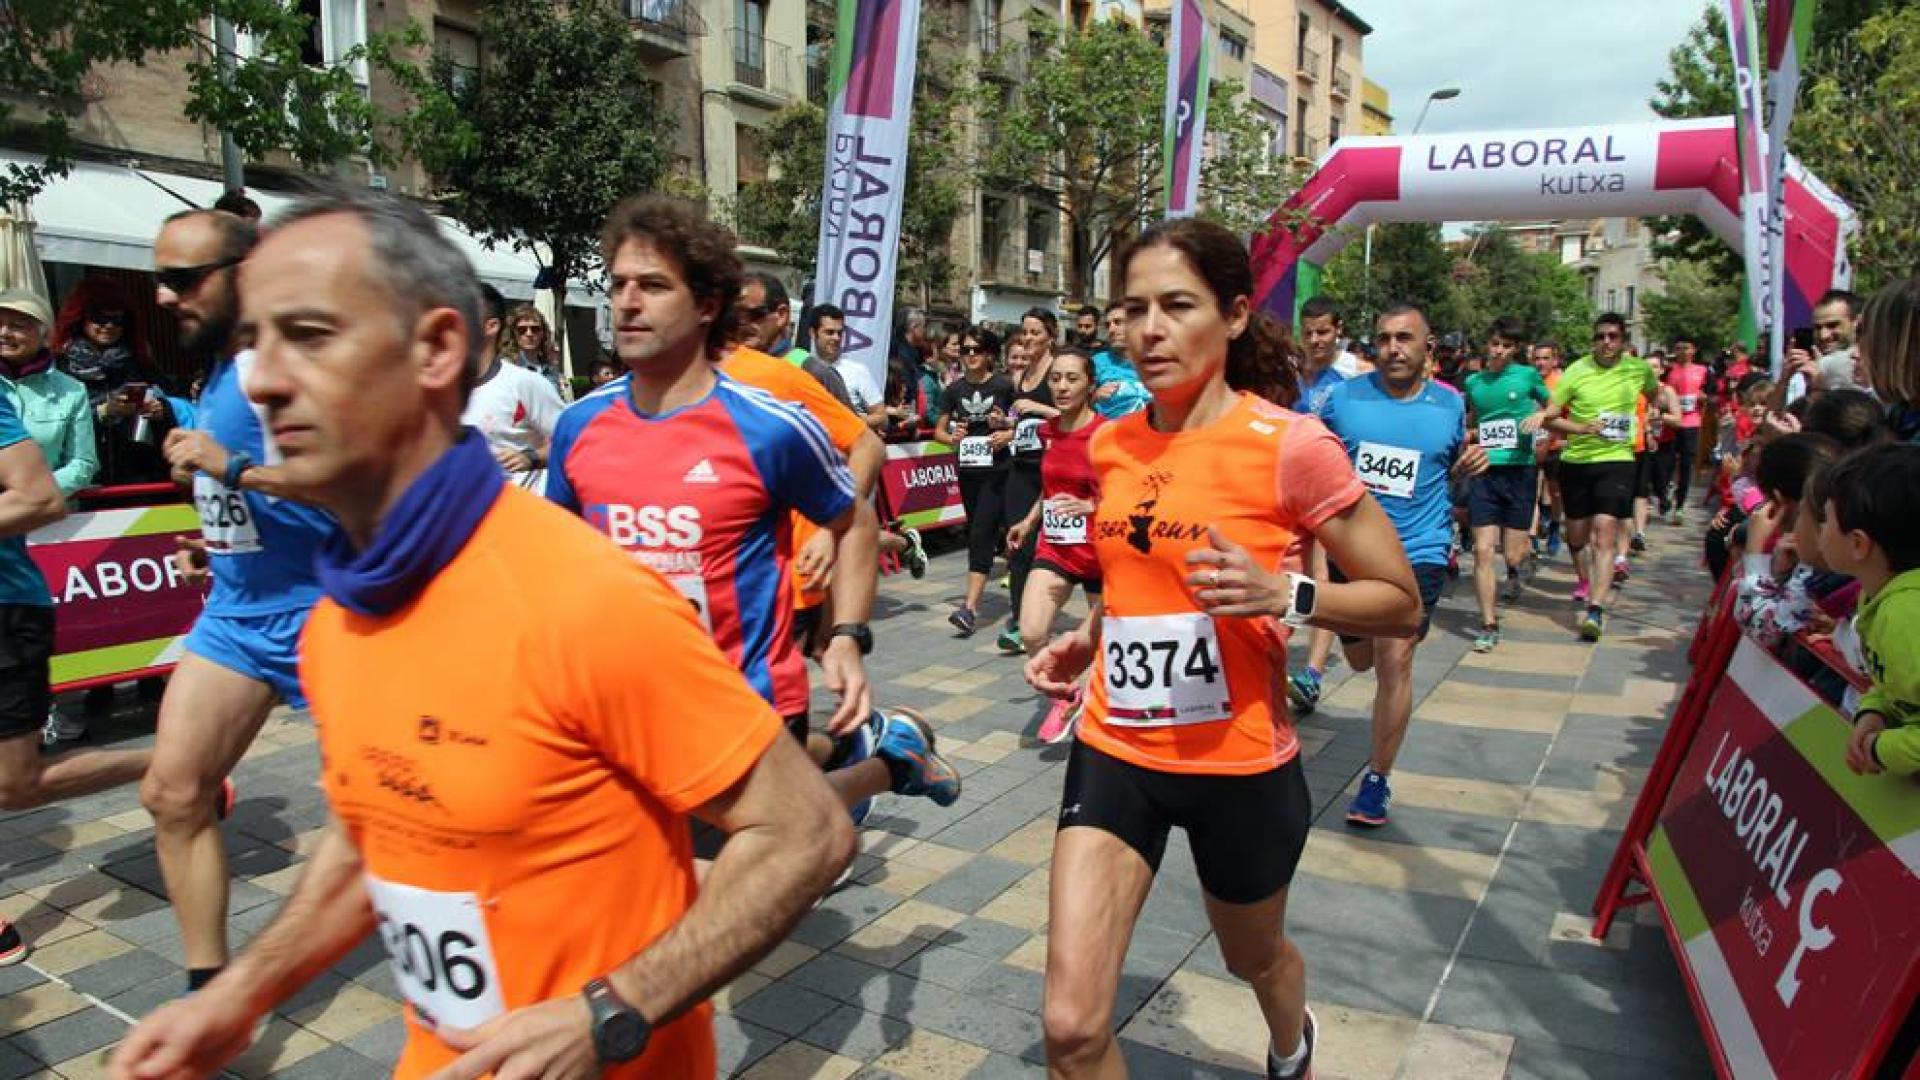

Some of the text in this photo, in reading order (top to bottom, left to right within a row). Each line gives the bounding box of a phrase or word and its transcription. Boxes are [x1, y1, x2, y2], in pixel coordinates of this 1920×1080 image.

[1427, 135, 1626, 171] LABORAL
[1540, 171, 1625, 195] kutxa
[1481, 425, 1515, 441] 3452
[1359, 452, 1415, 482] 3464
[1108, 636, 1219, 690] 3374
[1705, 729, 1810, 911] LABORAL
